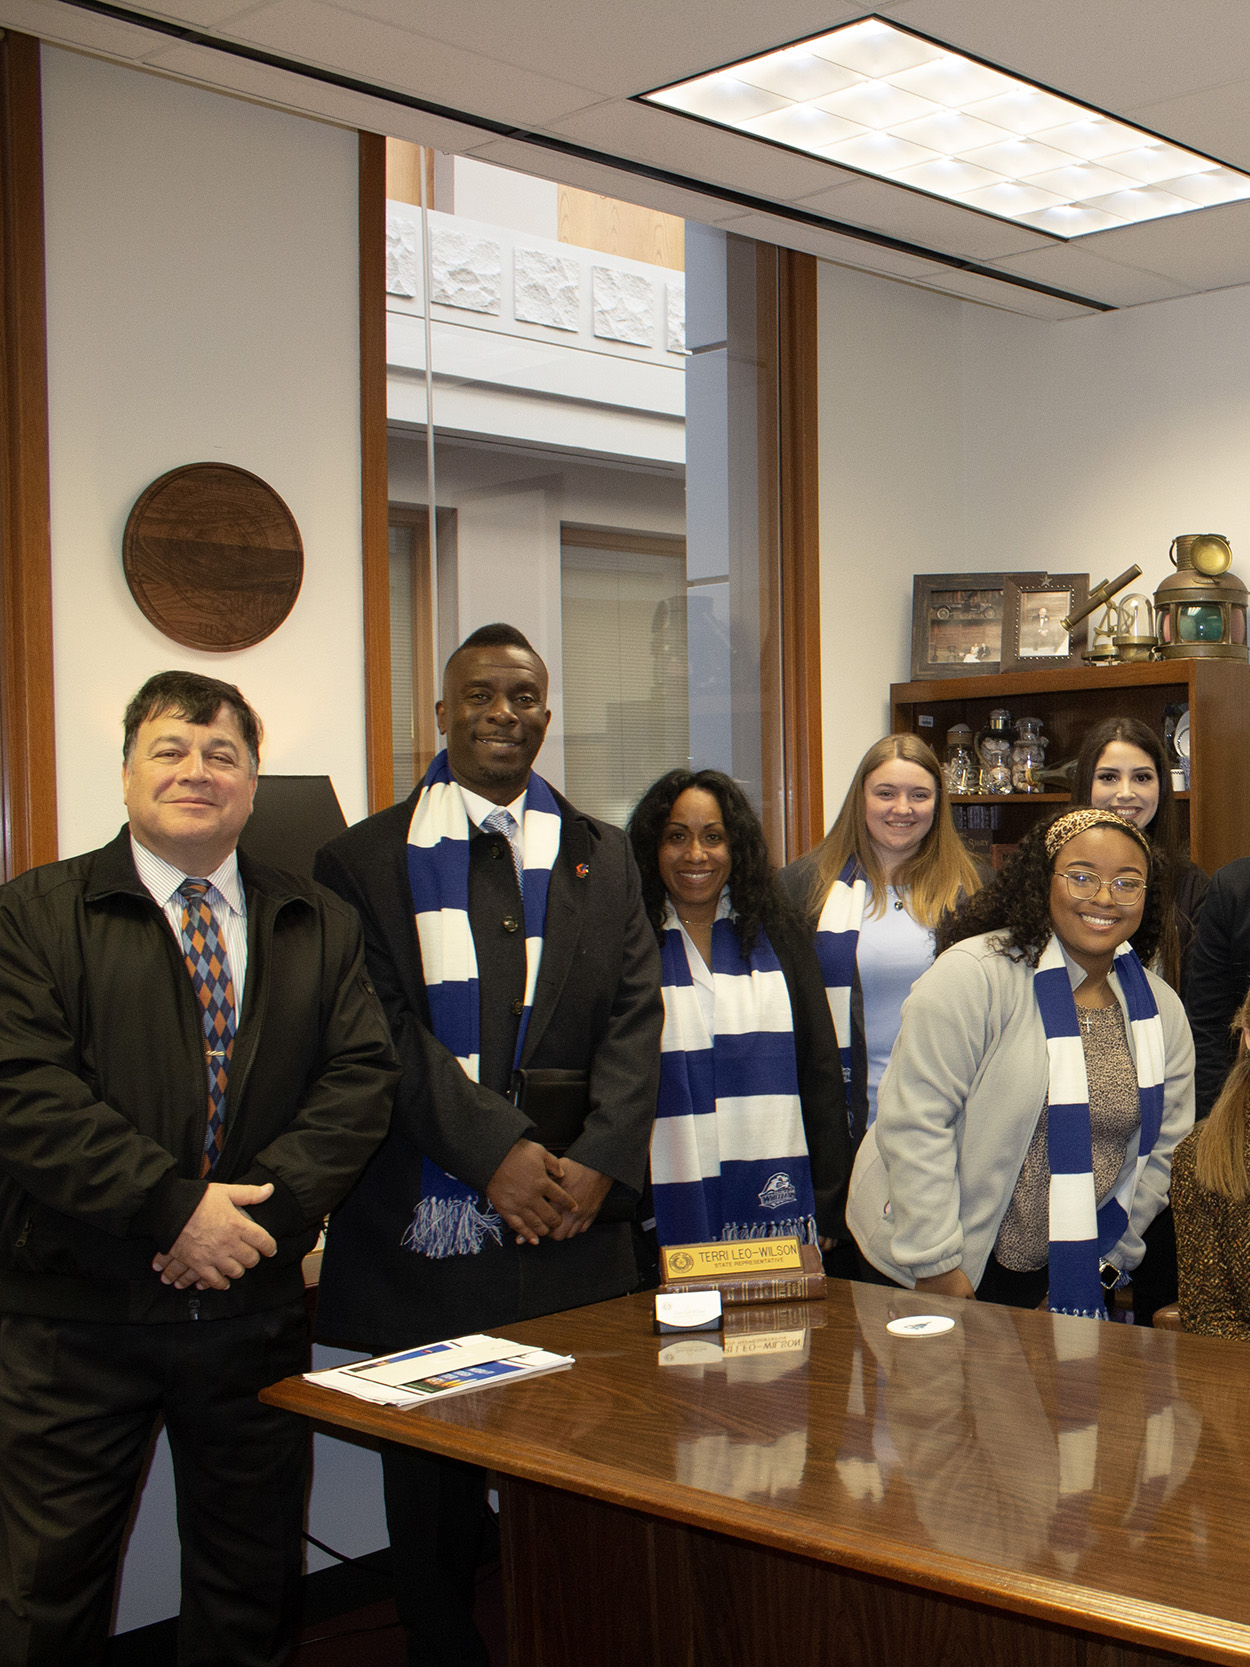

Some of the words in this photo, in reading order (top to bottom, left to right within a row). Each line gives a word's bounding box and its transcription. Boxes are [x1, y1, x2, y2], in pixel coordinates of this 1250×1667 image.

[698, 1251, 729, 1263] TERRI
[732, 1244, 797, 1260] LEO-WILSON
[714, 1261, 733, 1269] STATE
[734, 1256, 784, 1267] REPRESENTATIVE
